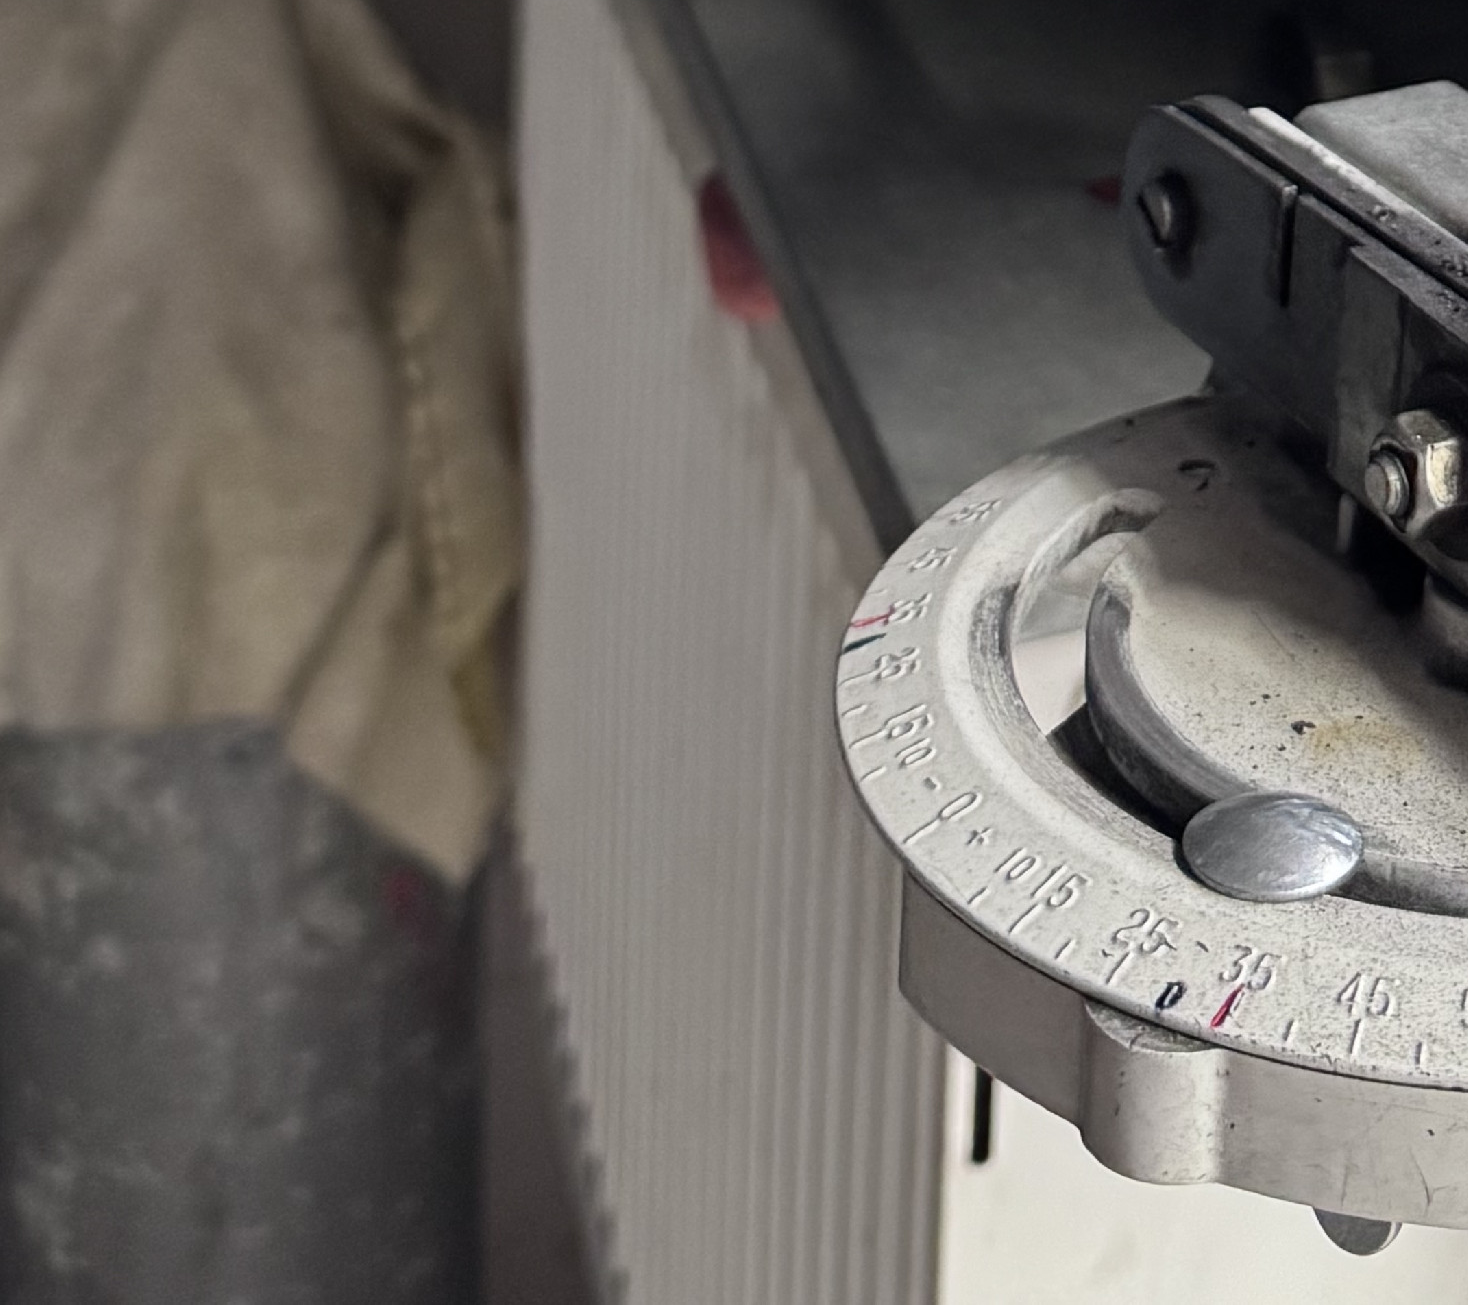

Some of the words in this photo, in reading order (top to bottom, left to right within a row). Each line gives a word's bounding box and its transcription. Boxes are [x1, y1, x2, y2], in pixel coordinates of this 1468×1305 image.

[873, 646, 922, 682] 25
[937, 791, 983, 823] 0
[993, 846, 1042, 884] 10
[1030, 861, 1094, 901] 15
[1110, 907, 1184, 955] 25
[1217, 944, 1289, 991] 35
[1335, 971, 1402, 1018] 45
